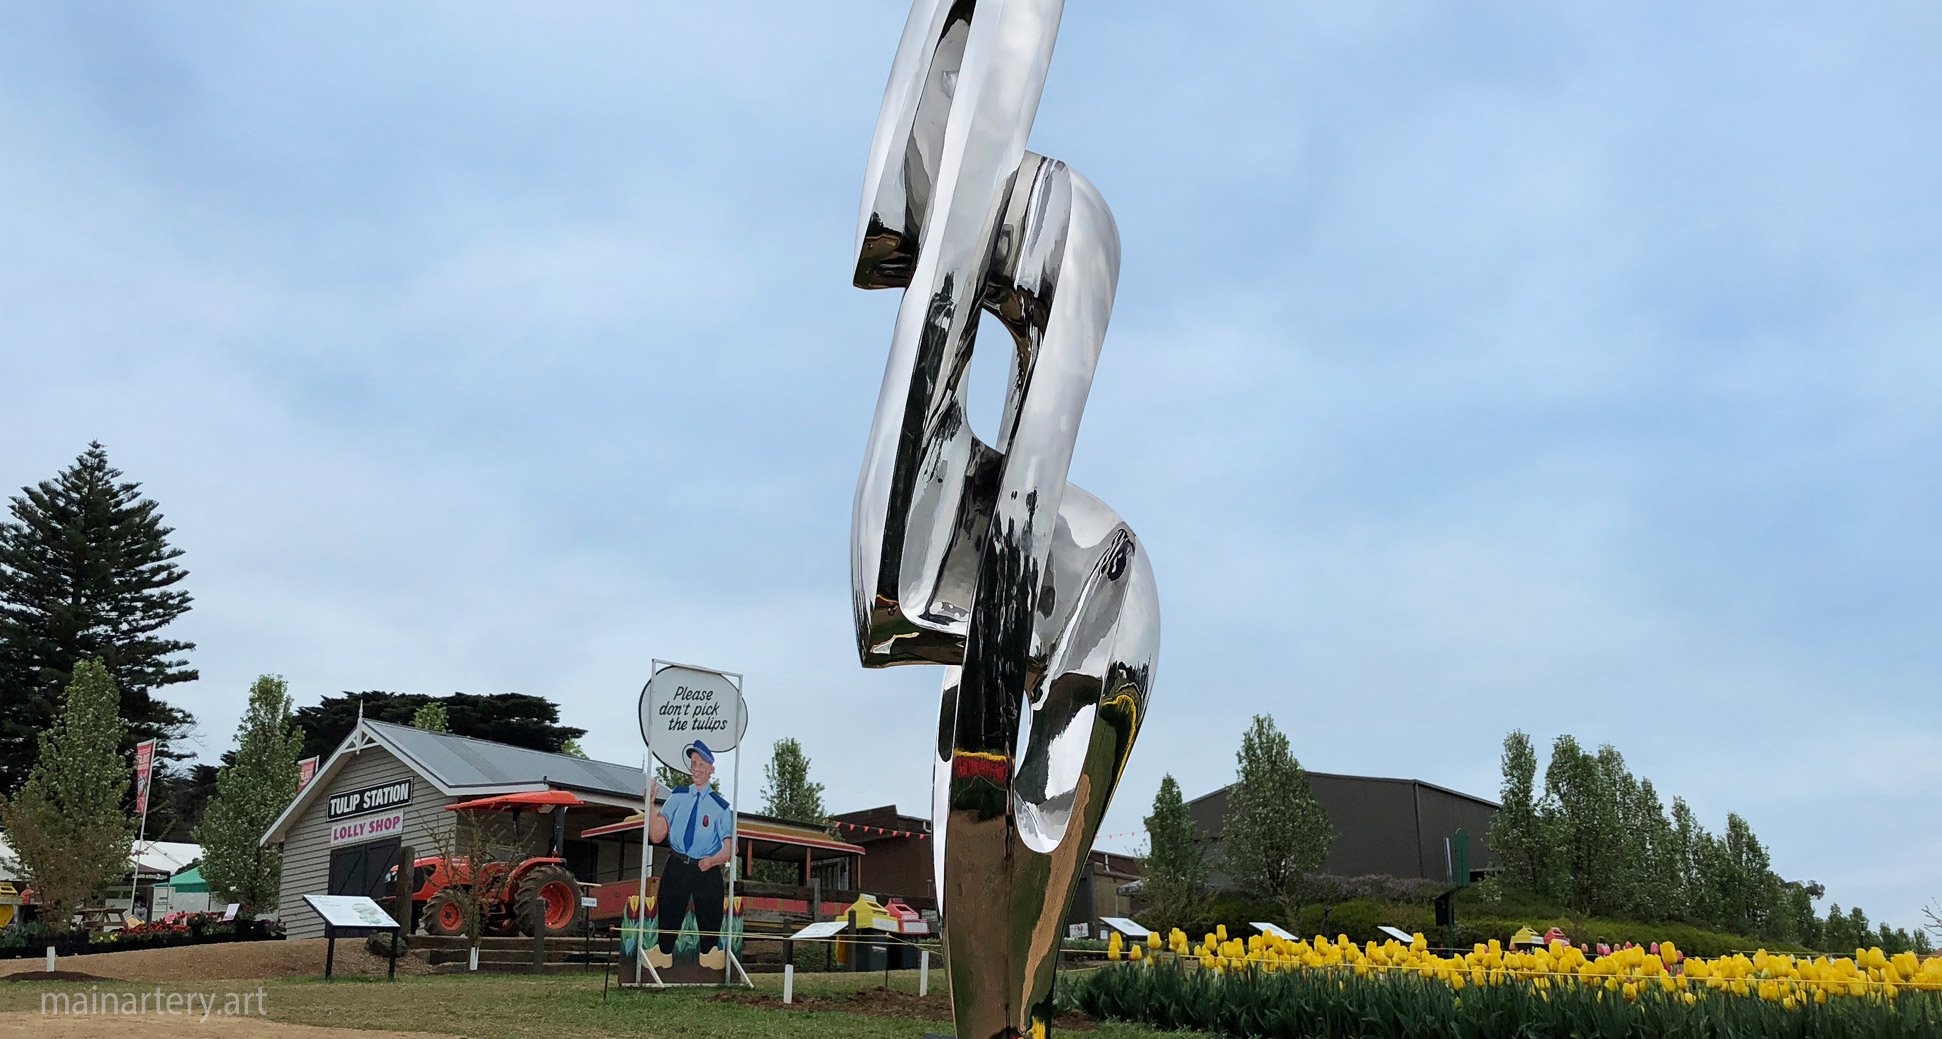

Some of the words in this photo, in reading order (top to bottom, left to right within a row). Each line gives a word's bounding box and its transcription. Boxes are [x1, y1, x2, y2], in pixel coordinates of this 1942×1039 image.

[673, 686, 714, 701] Please
[659, 701, 691, 716] don't
[692, 701, 720, 718] pick
[668, 717, 688, 731] the
[691, 716, 728, 732] tulips
[330, 794, 360, 816] TULIP
[363, 782, 409, 809] STATION
[333, 822, 366, 841] LOLLY
[369, 815, 401, 834] SHOP
